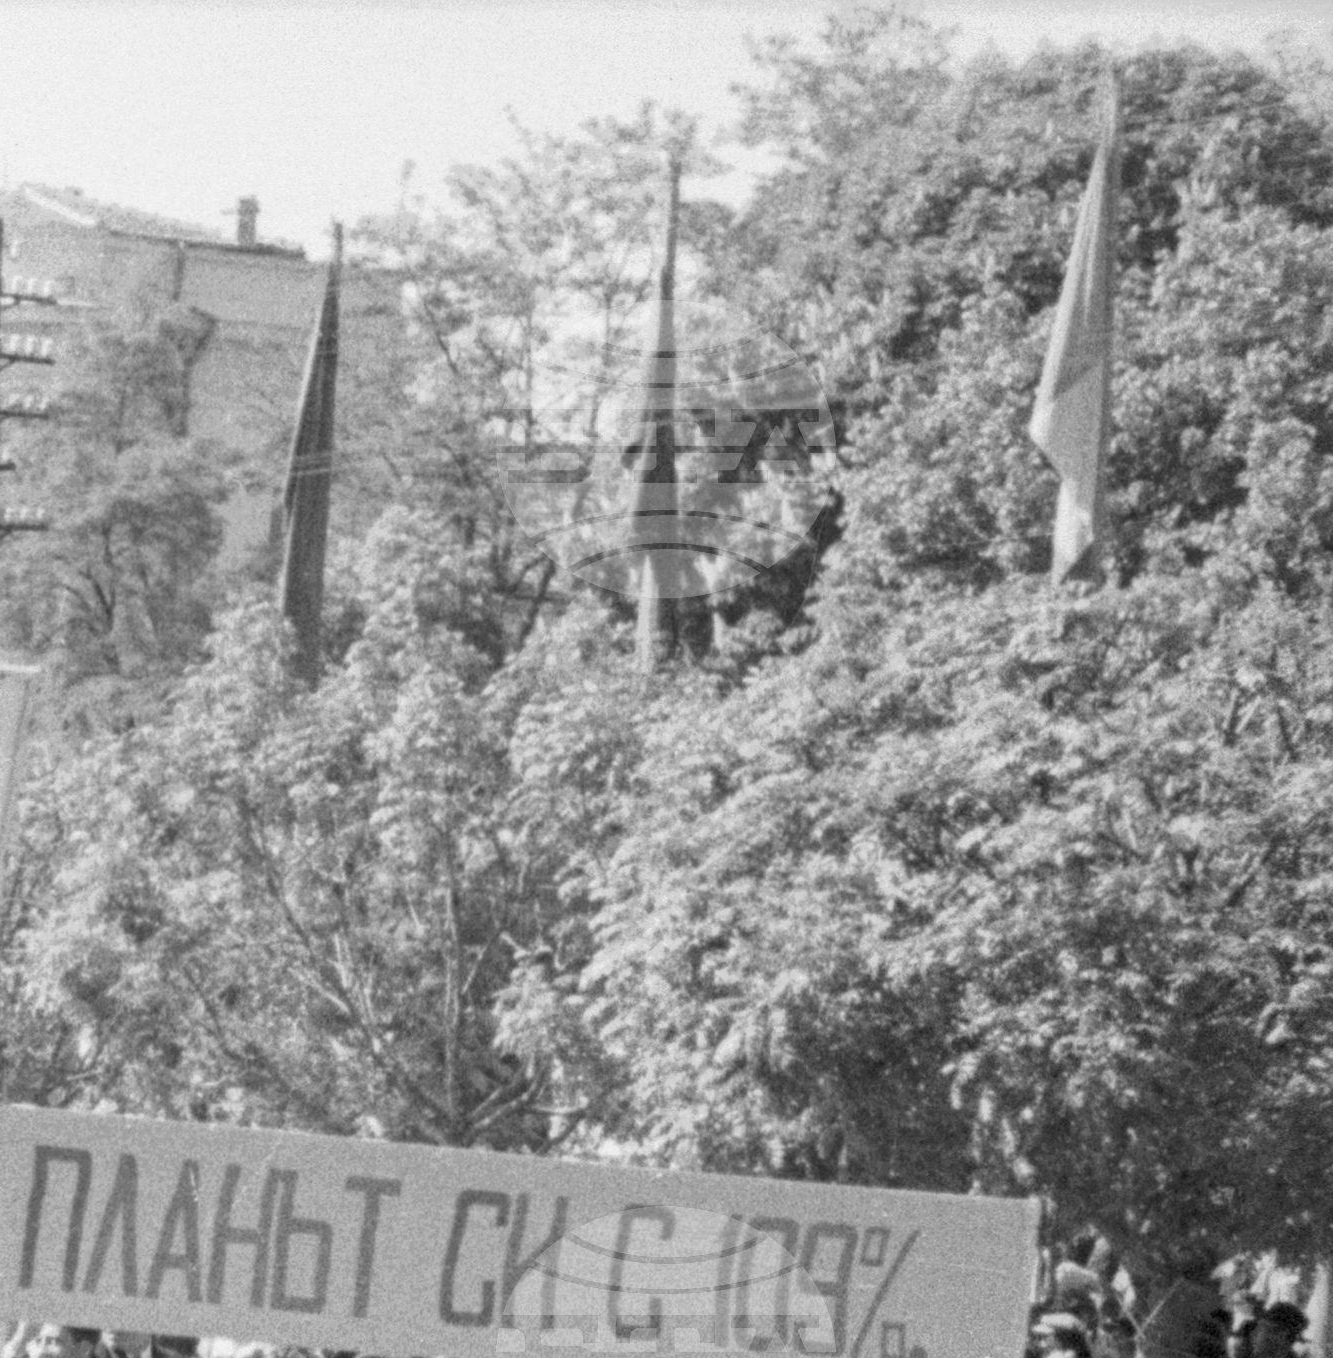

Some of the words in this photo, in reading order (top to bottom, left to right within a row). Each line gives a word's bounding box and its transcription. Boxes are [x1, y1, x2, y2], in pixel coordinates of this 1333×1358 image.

[16, 1144, 403, 1319] ПЛАНЪТ
[438, 1188, 570, 1331] СИ
[606, 1203, 677, 1340] С
